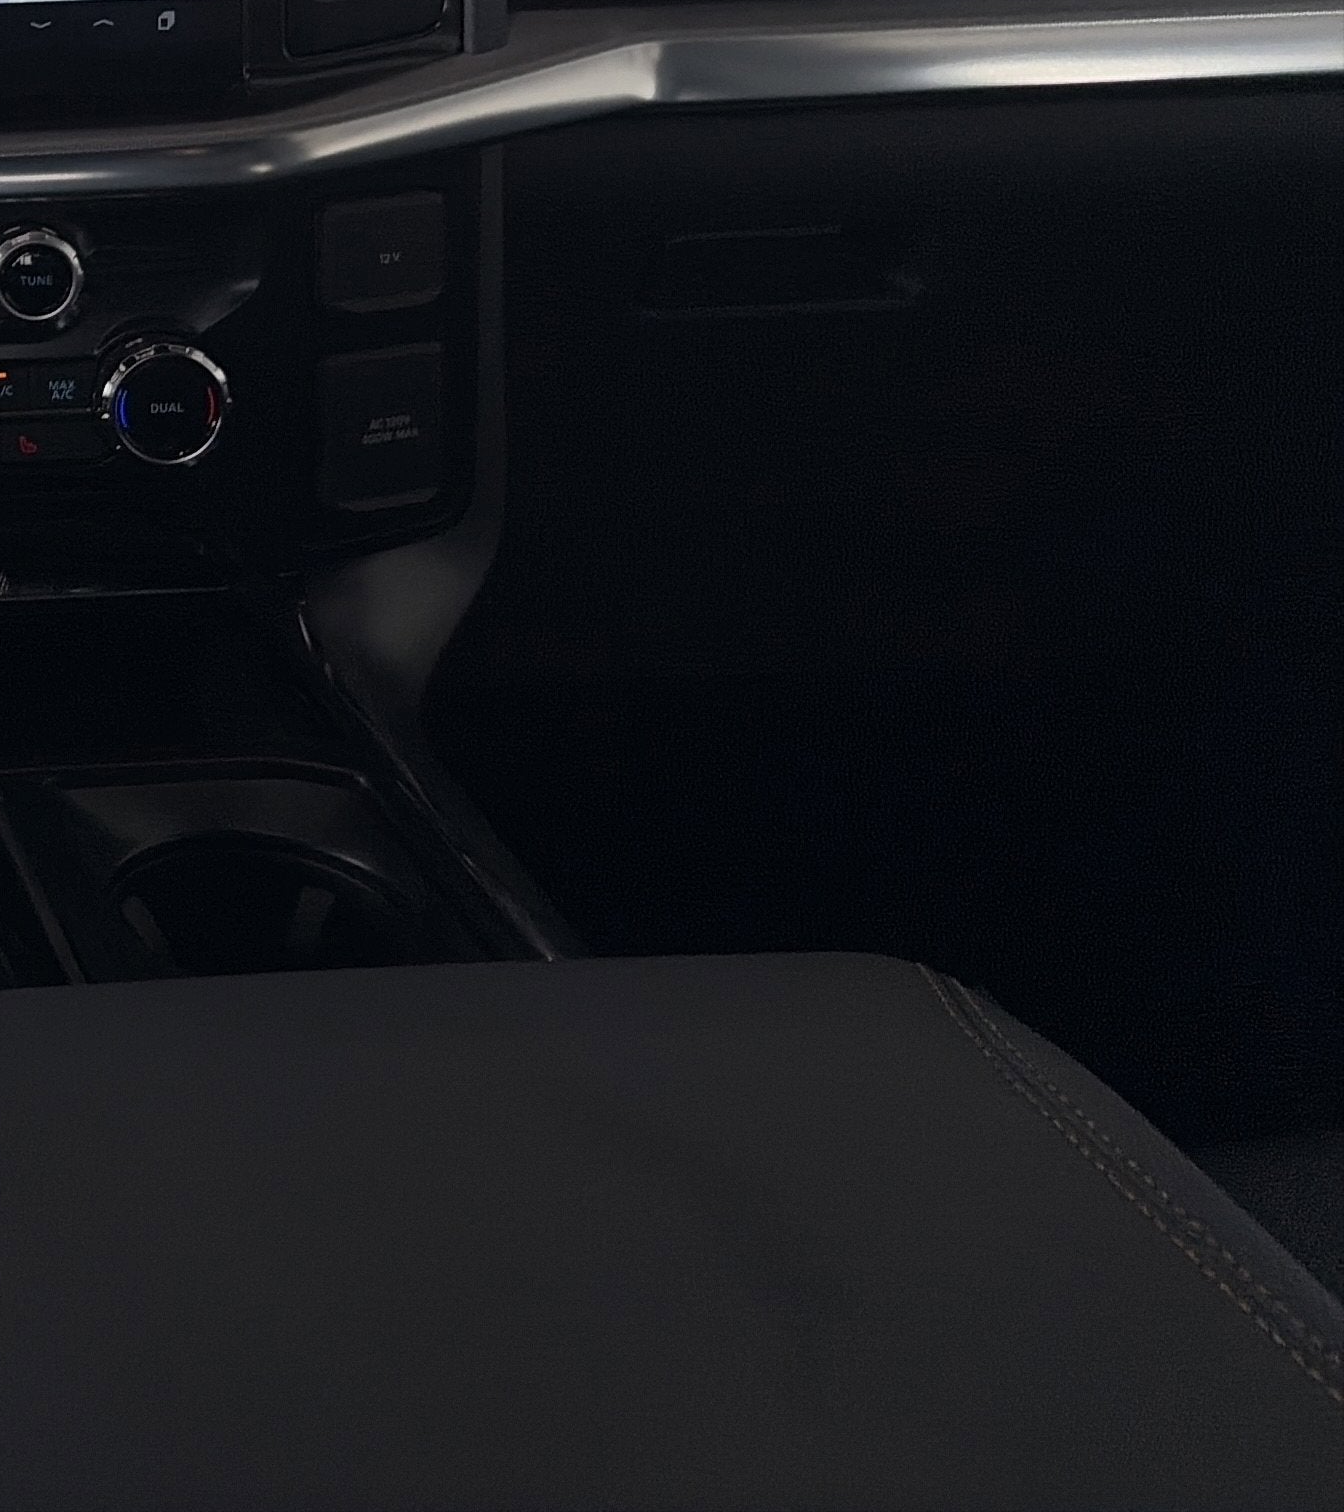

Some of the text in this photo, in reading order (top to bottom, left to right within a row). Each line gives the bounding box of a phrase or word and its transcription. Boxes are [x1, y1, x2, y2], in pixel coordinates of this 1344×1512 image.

[20, 275, 55, 286] TUNE
[49, 379, 76, 391] MAX
[51, 389, 73, 401] A/C
[150, 402, 184, 414] DUAL
